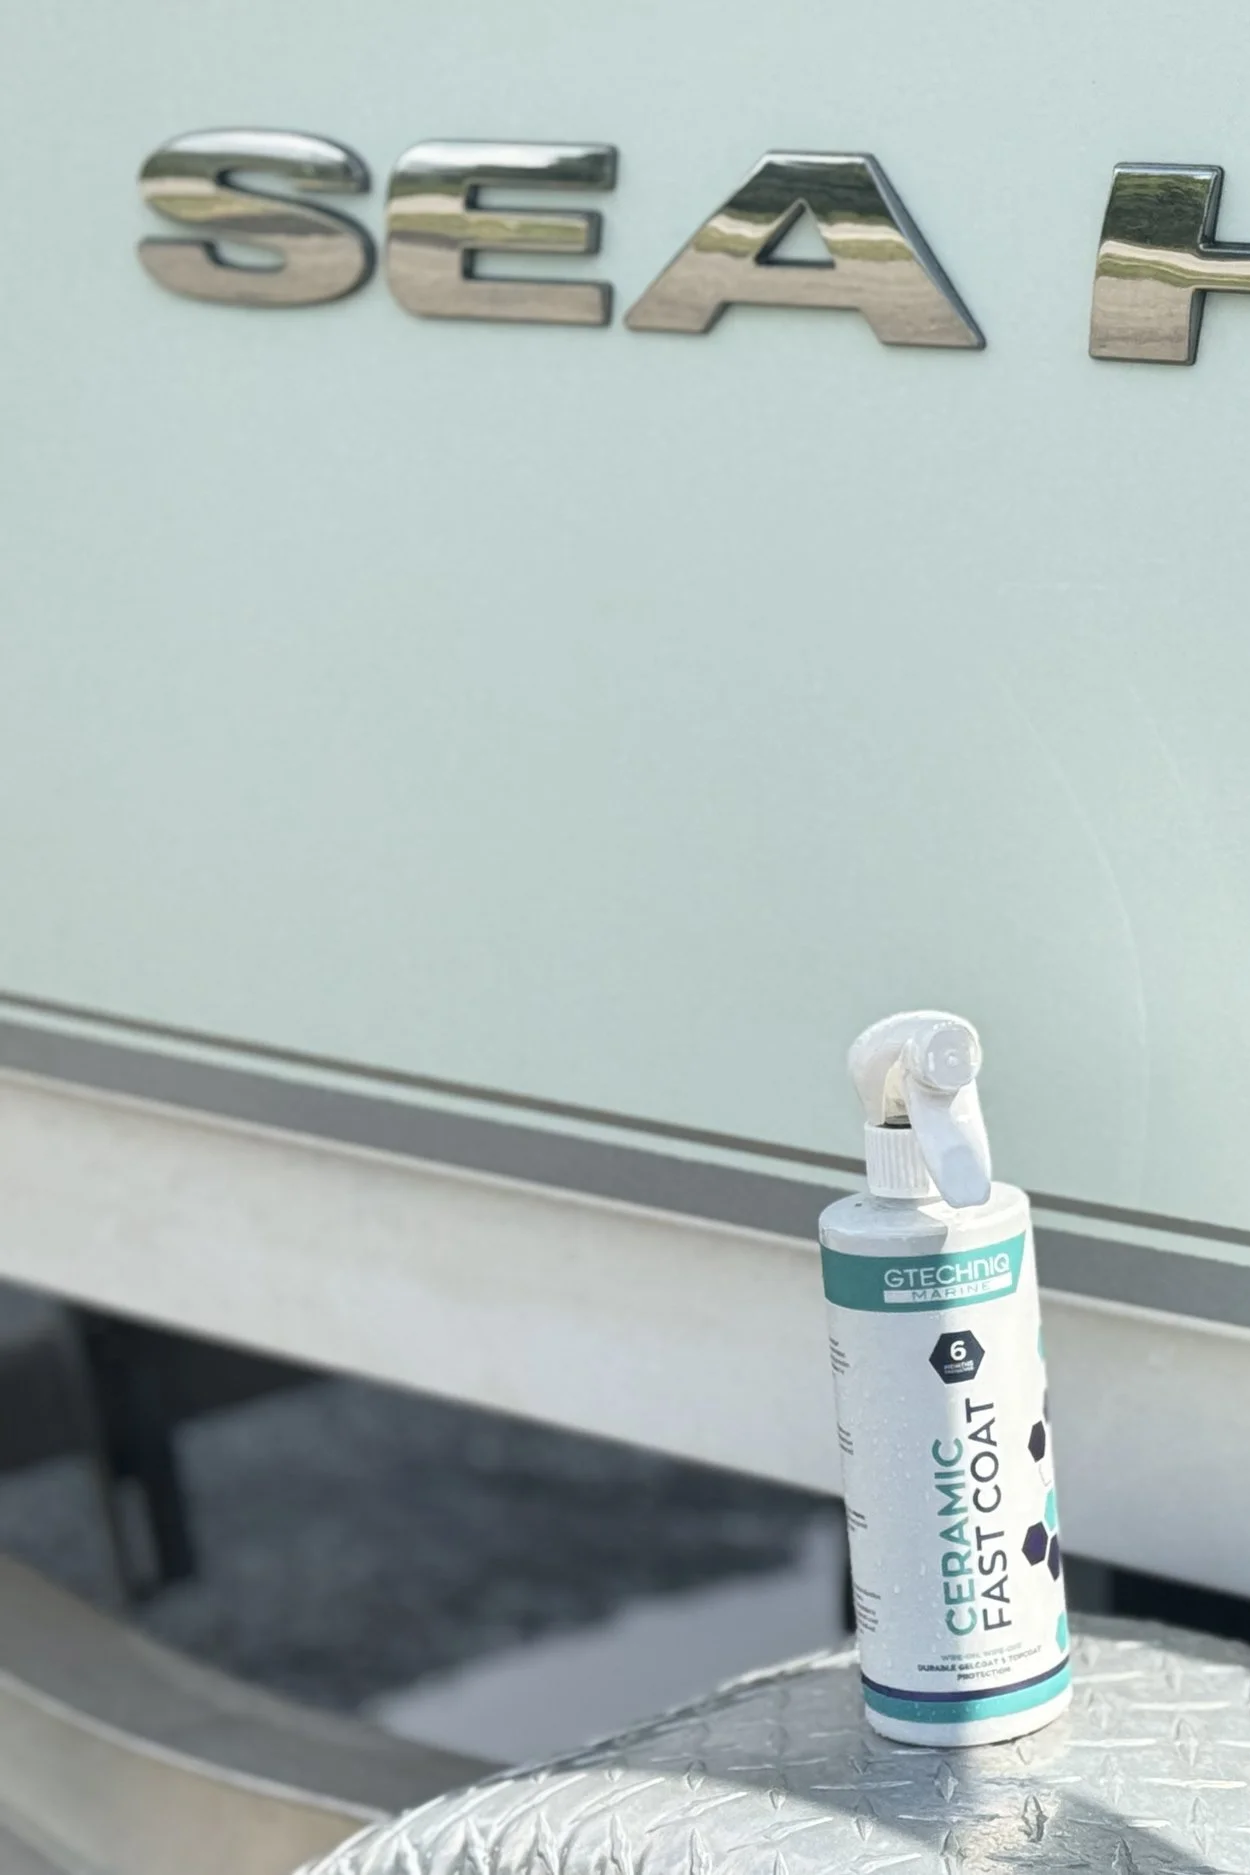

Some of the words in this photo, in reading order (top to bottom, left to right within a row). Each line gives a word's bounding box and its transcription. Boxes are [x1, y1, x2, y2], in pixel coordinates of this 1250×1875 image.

[137, 126, 987, 350] SEA
[884, 1253, 1010, 1288] GTECHNIQ
[912, 1281, 992, 1300] MARINE
[950, 1340, 967, 1361] 6
[965, 1398, 1000, 1513] COAT
[932, 1438, 977, 1636] CERAMIC
[975, 1526, 1012, 1631] FAST
[957, 1667, 1011, 1680] PROTECTION
